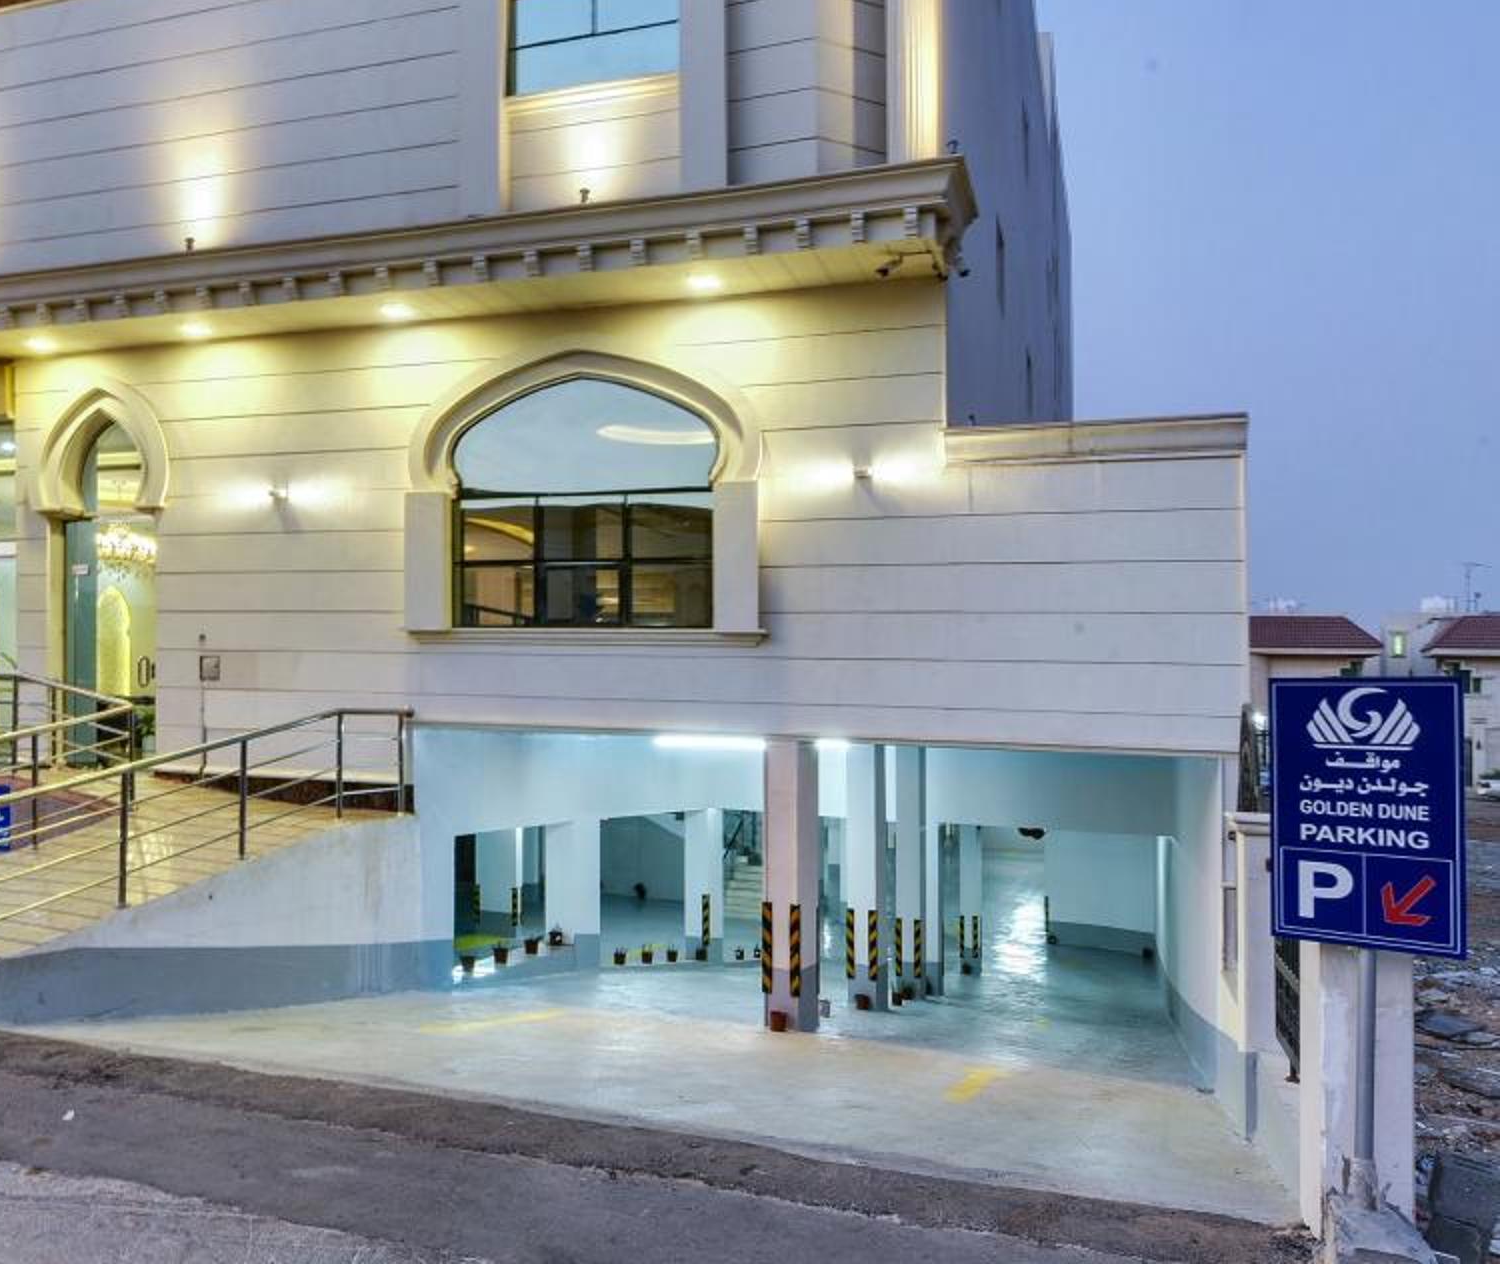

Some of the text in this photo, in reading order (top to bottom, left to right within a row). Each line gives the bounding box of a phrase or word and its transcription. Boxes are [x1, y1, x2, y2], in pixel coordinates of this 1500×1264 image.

[1325, 751, 1401, 774] مواقف
[1299, 775, 1429, 797] جولدن ديون
[1299, 799, 1431, 822] GOLDEN DUNE
[1300, 823, 1430, 850] PARKING
[1297, 859, 1354, 919] P
